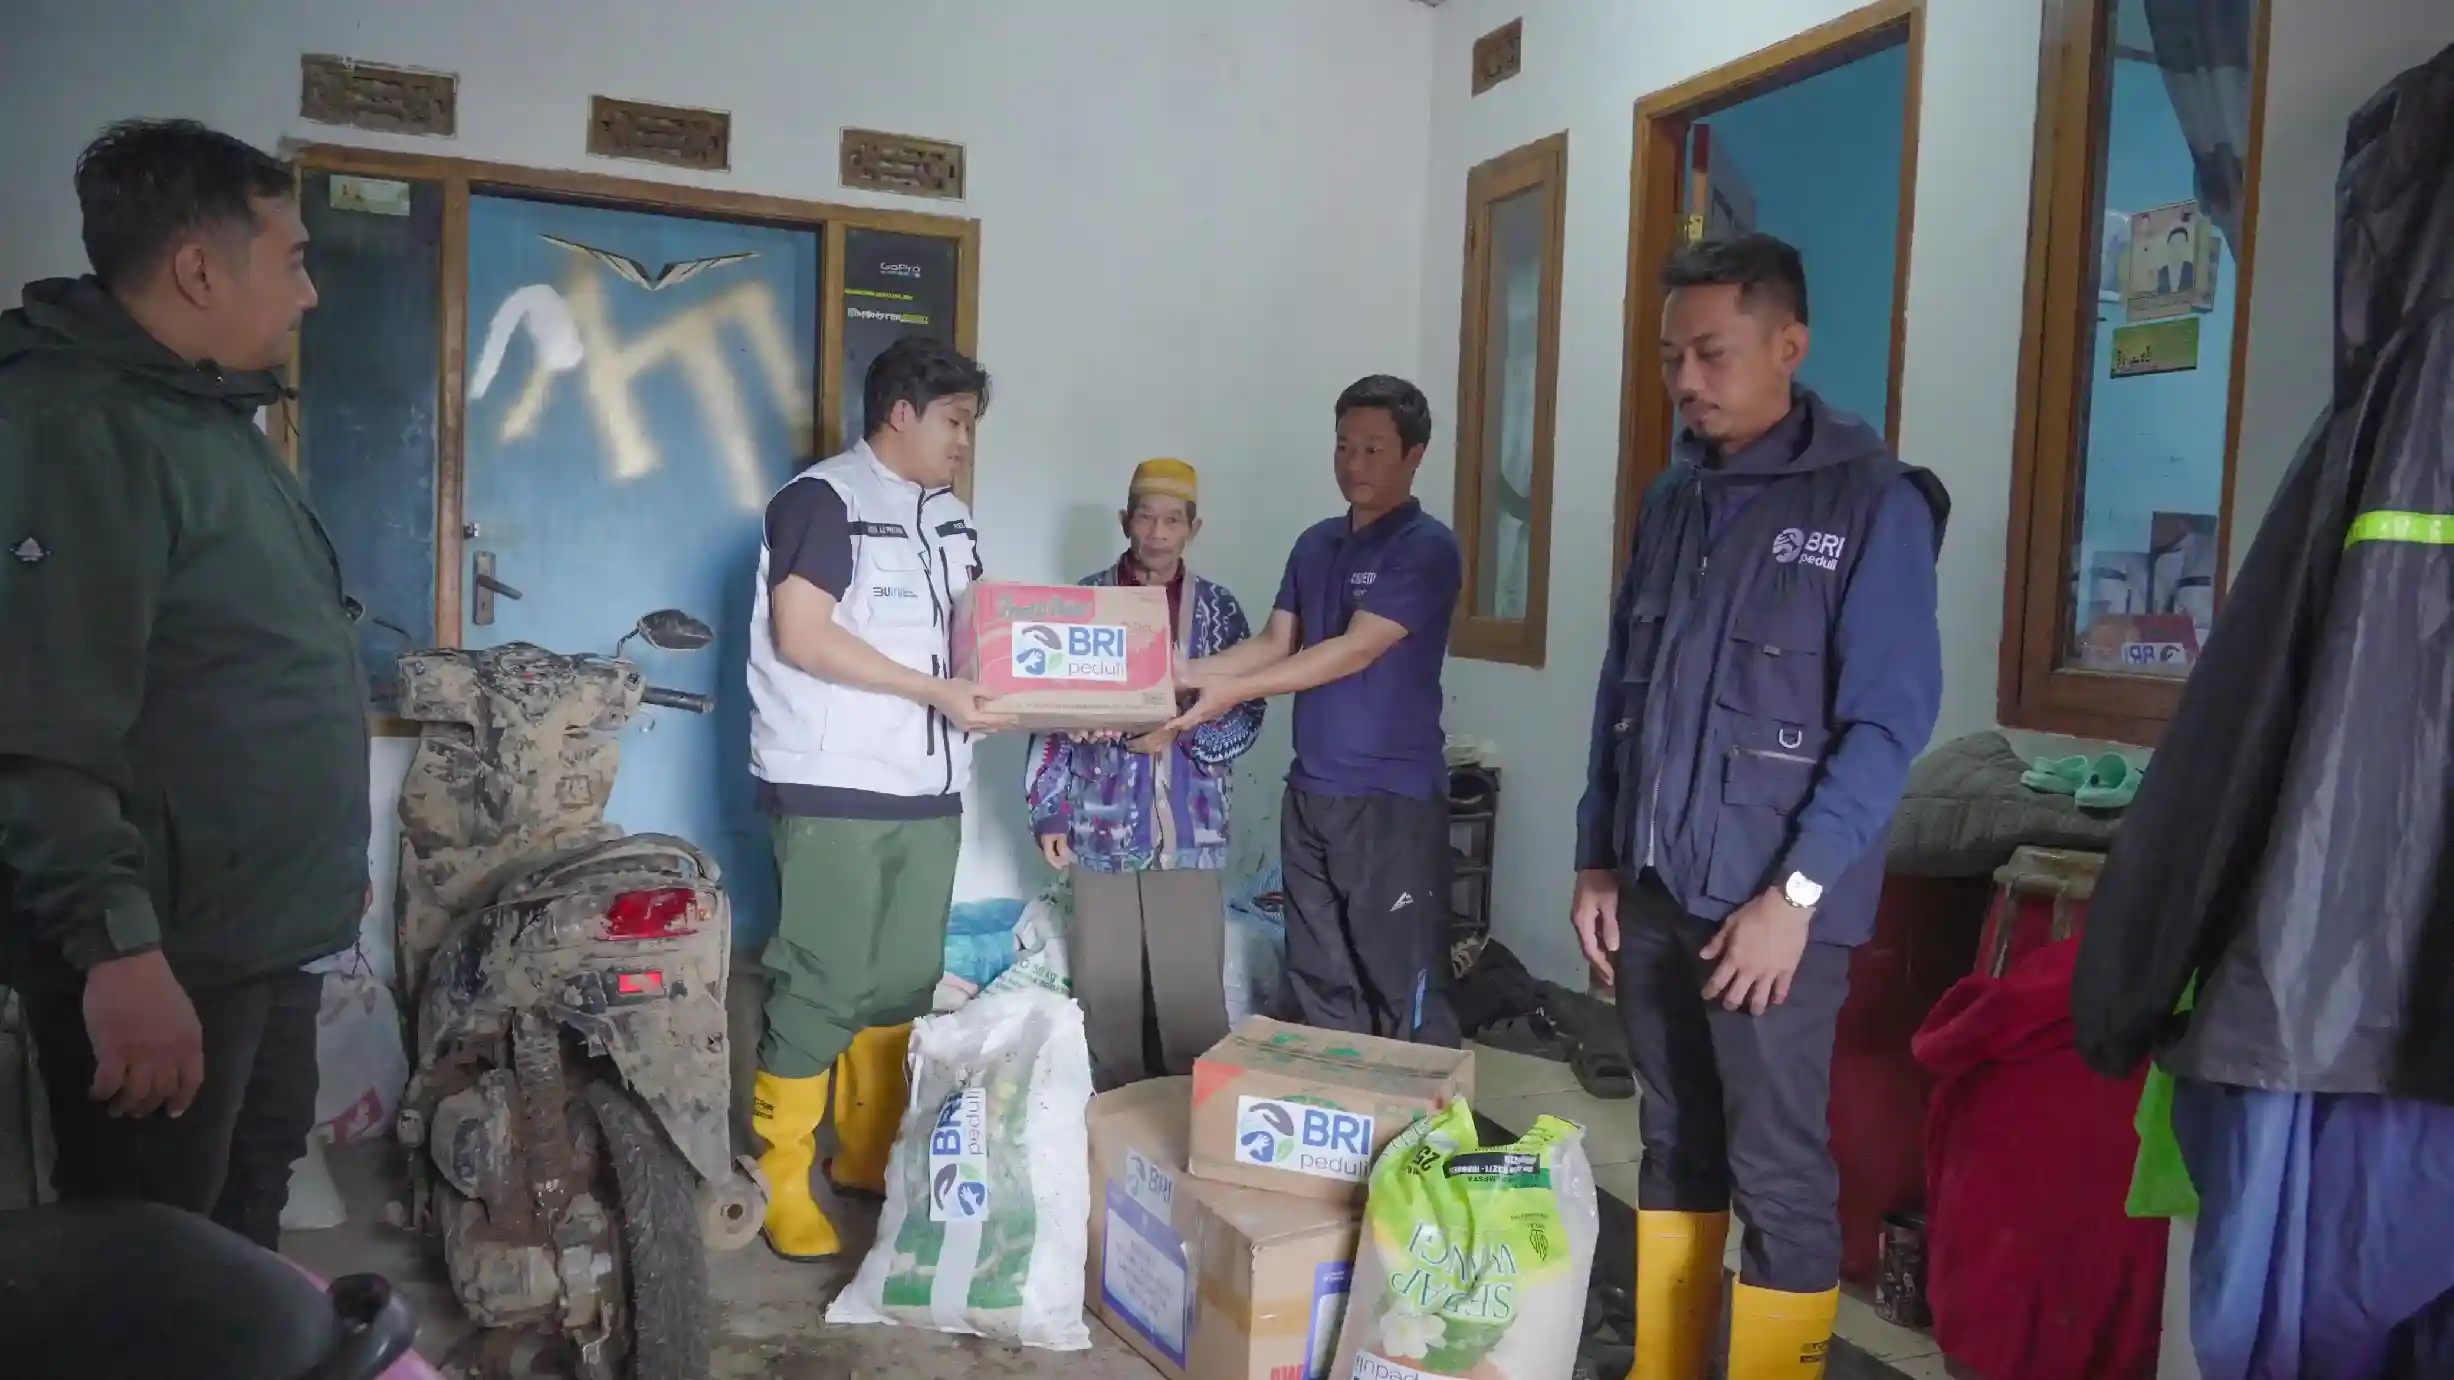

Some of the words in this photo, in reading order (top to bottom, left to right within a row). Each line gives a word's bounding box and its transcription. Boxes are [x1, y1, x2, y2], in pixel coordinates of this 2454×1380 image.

[880, 262, 921, 272] GoPro
[1804, 531, 1846, 558] BRI
[1798, 552, 1838, 571] peduli
[1068, 626, 1124, 658] BRI
[1069, 660, 1124, 677] peduli
[966, 1090, 984, 1155] peduli
[1302, 1109, 1371, 1156] BRI
[1300, 1153, 1370, 1177] peduli
[1411, 1146, 1441, 1172] 25
[1149, 1164, 1171, 1204] BRI
[1391, 1268, 1512, 1318] SEDAP
